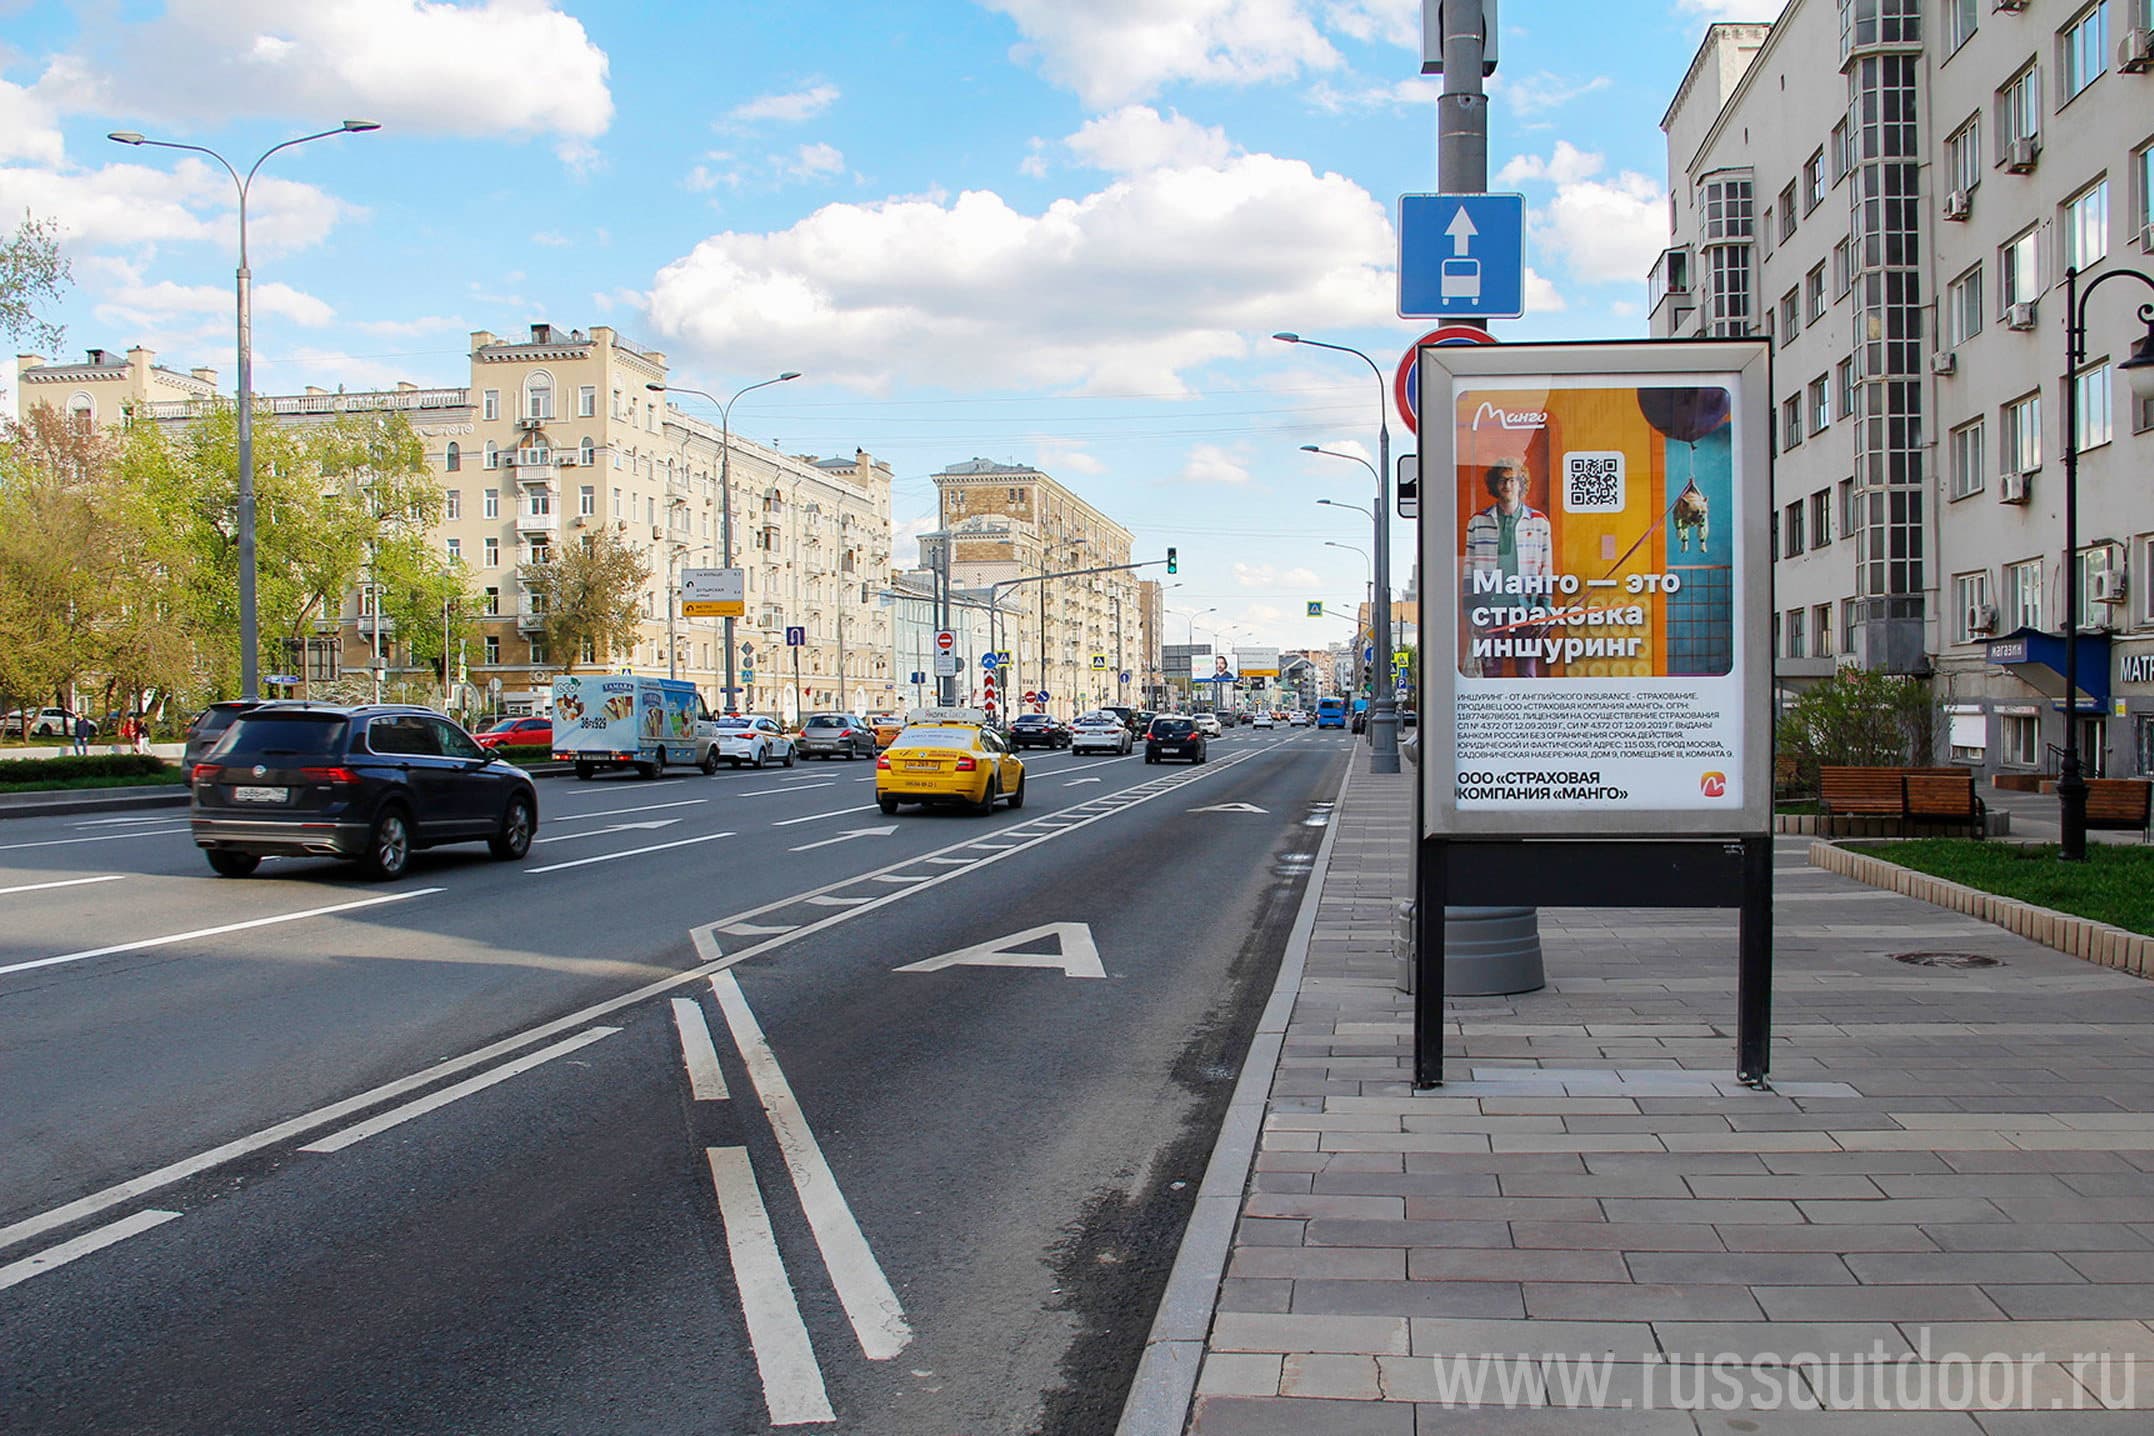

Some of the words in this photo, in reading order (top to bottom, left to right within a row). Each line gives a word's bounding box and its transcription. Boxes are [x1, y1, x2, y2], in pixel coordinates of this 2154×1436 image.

[1472, 400, 1548, 432] Манго
[1472, 568, 1579, 595] Манго
[1625, 572, 1681, 595] это
[1472, 603, 1643, 632] страховка
[1472, 635, 1643, 663] иншуринг
[1509, 693, 1521, 701] ОТ
[1522, 693, 1583, 701] АНГЛИЙСКОГО
[1584, 692, 1630, 701] INSURANCE
[1457, 703, 1502, 711] ПРОДАВЕЦ
[1503, 703, 1522, 711] ООО
[1577, 702, 1624, 711] КОМПАНИЯ
[1523, 712, 1569, 721] ЛИЦЕНЗИИ
[1570, 712, 1582, 721] НА
[1583, 712, 1658, 720] ОСУЩЕСТВЛЕНИЕ
[1659, 711, 1720, 720] СТРАХОВАНИЯ
[1501, 722, 1514, 730] ОТ
[1612, 722, 1624, 730] ОТ
[1675, 721, 1713, 730] ВЫДАНЫ
[1457, 732, 1492, 740] БАНКОМ
[1494, 732, 1528, 740] РОССИИ
[1530, 731, 1545, 740] БЕЗ
[1547, 731, 1607, 740] ОГРАНИЧЕНИЯ
[1608, 731, 1636, 740] СРОКА
[1457, 741, 1522, 750] ЮРИДИЧЕСКИЙ
[1530, 741, 1592, 749] ФАКТИЧЕСКИЙ
[1657, 741, 1685, 749] ГОРОД
[1457, 751, 1530, 759] САДОВНИЧЕСКАЯ
[1591, 750, 1611, 759] ДОМ
[1620, 750, 1675, 759] ПОМЕЩЕНИЕ
[1686, 750, 1725, 759] КОМНАТА
[1457, 771, 1494, 785] ООО
[1496, 771, 1600, 785] «СТРАХОВАЯ
[1458, 786, 1551, 800] КОМПАНИЯ
[1553, 786, 1628, 800] «МАНГО»
